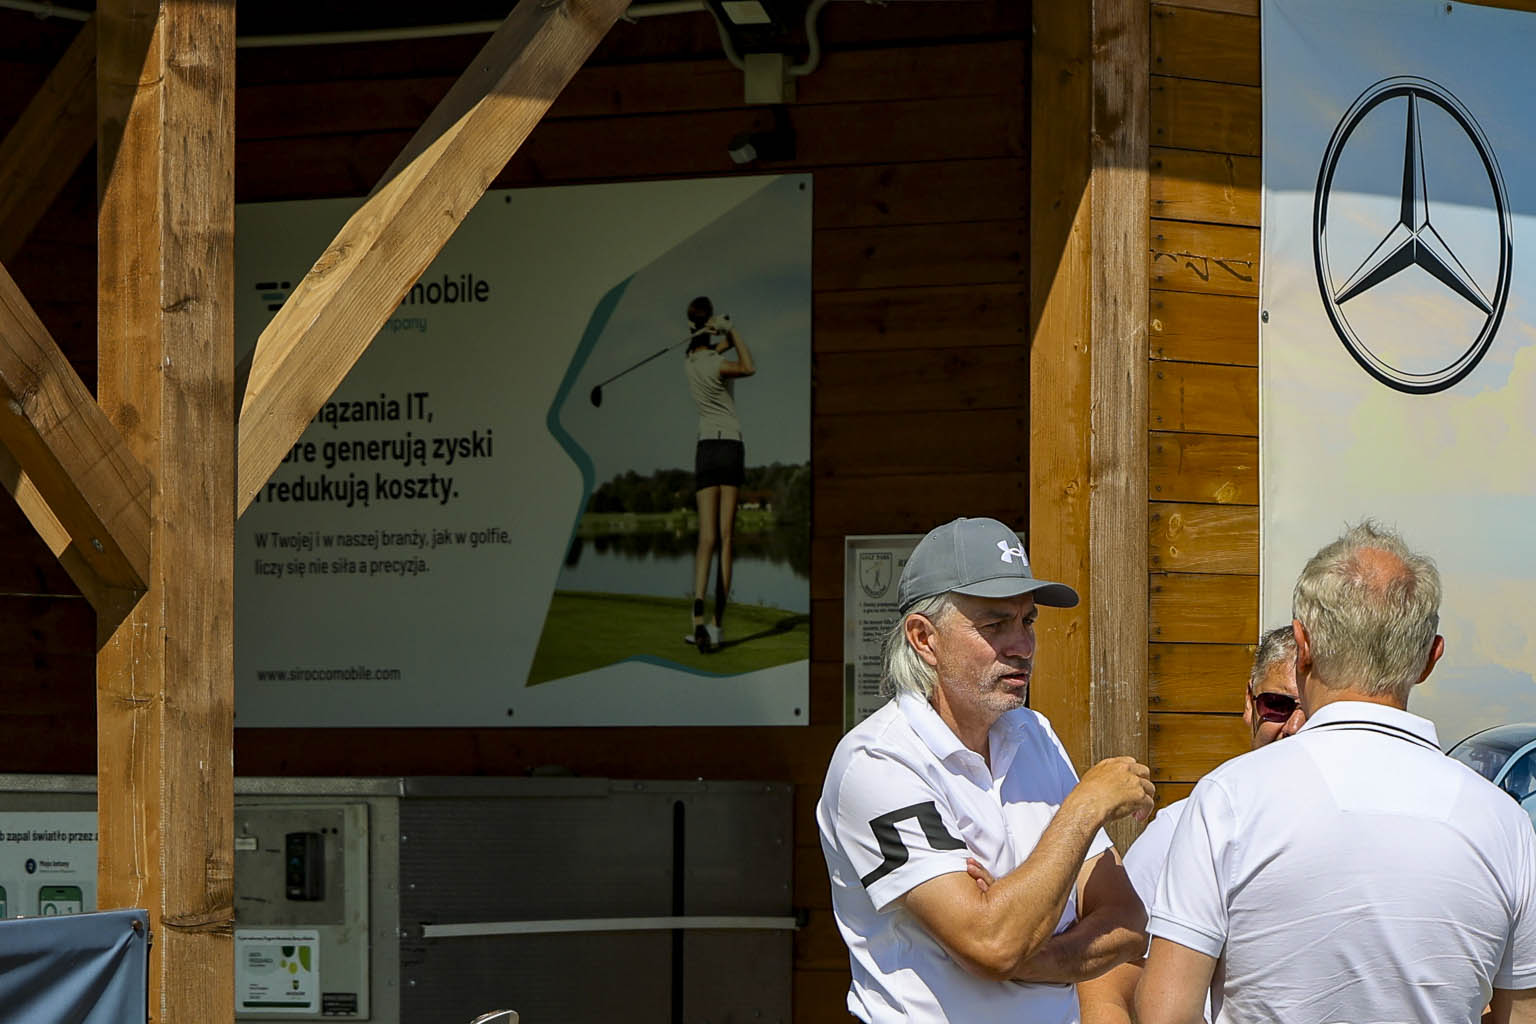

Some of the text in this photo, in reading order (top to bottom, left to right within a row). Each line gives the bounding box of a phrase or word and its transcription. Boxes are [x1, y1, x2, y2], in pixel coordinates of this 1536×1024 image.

[406, 391, 434, 424] IT,
[323, 433, 427, 469] generują
[432, 429, 493, 466] zyski
[266, 474, 370, 508] redukują
[375, 473, 459, 505] koszty.
[254, 532, 268, 549] W
[271, 531, 314, 552] Twojej
[315, 531, 321, 548] i
[323, 535, 335, 548] w
[337, 530, 380, 551] naszej
[431, 528, 452, 550] jak
[455, 532, 468, 546] w
[254, 557, 430, 579] liczy się nie siła a precyzja.
